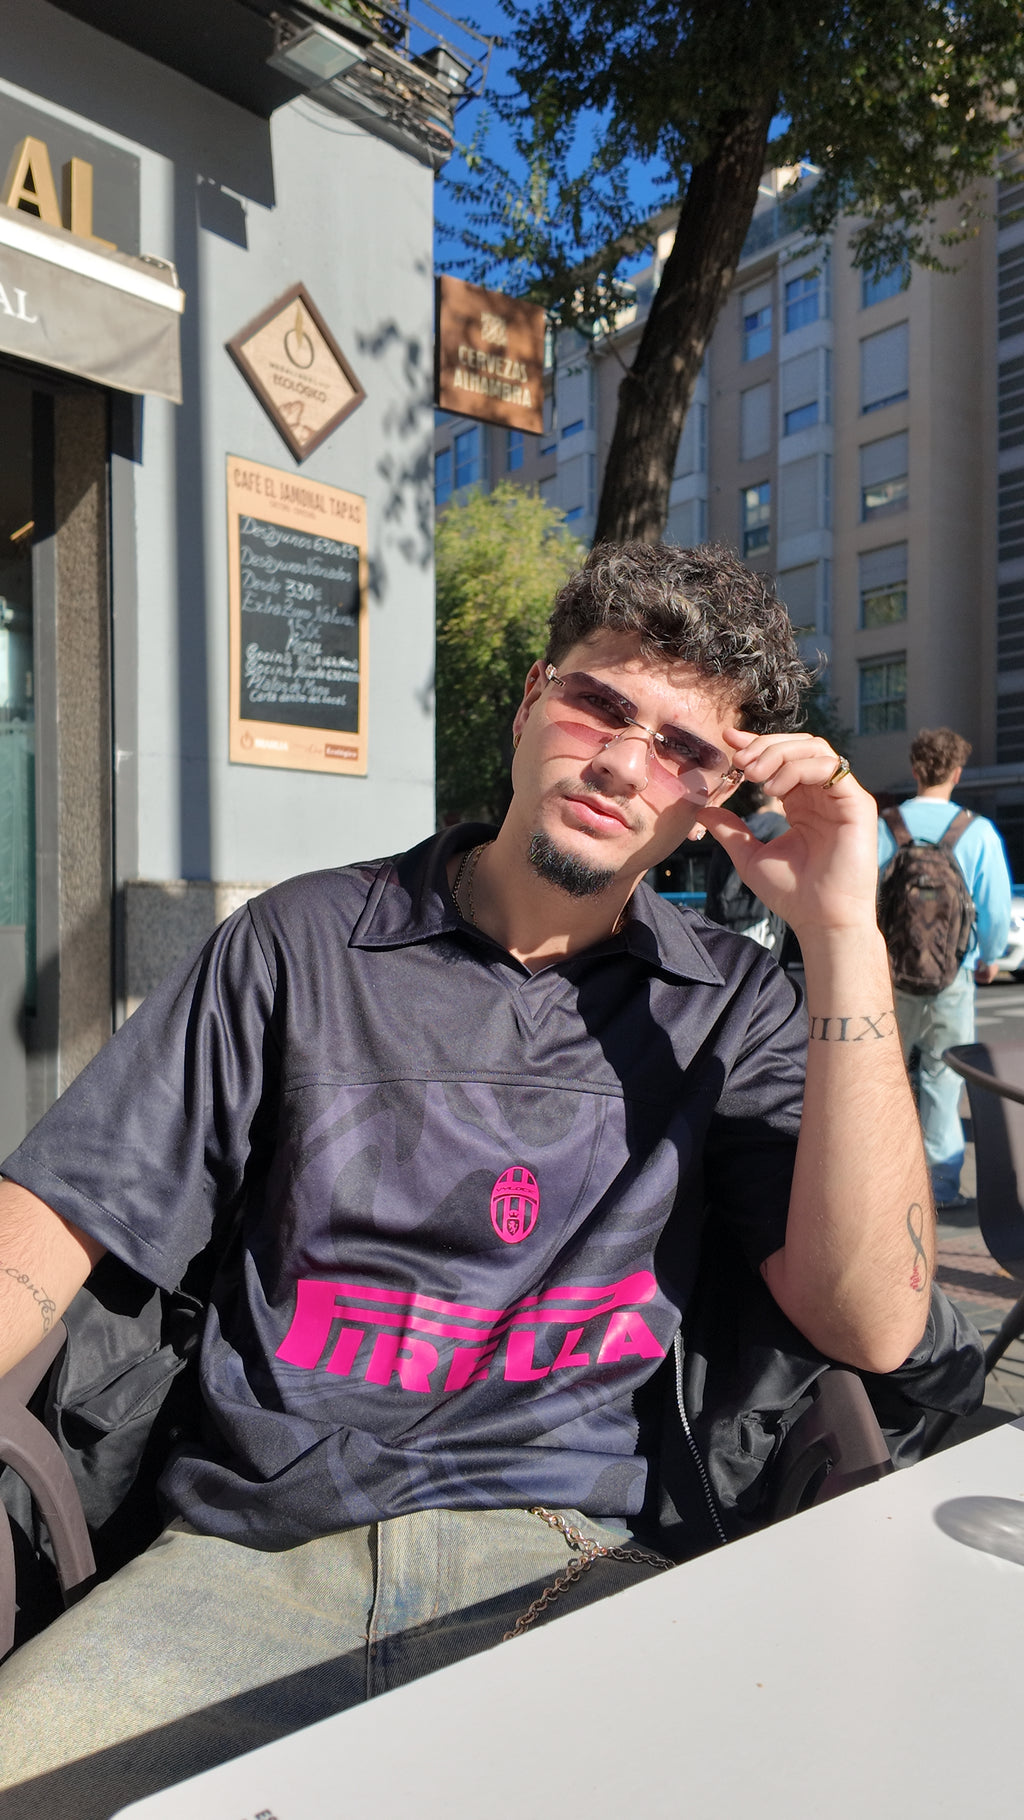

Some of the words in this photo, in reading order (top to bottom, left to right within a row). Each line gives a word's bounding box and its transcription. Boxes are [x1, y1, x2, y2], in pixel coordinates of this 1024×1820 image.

[458, 344, 528, 383] CERVEZAS
[453, 367, 532, 408] ALHAMBRA
[264, 477, 277, 499] EL
[329, 497, 361, 525] TAPAS
[242, 568, 281, 594] Desde
[241, 591, 281, 617] Extra
